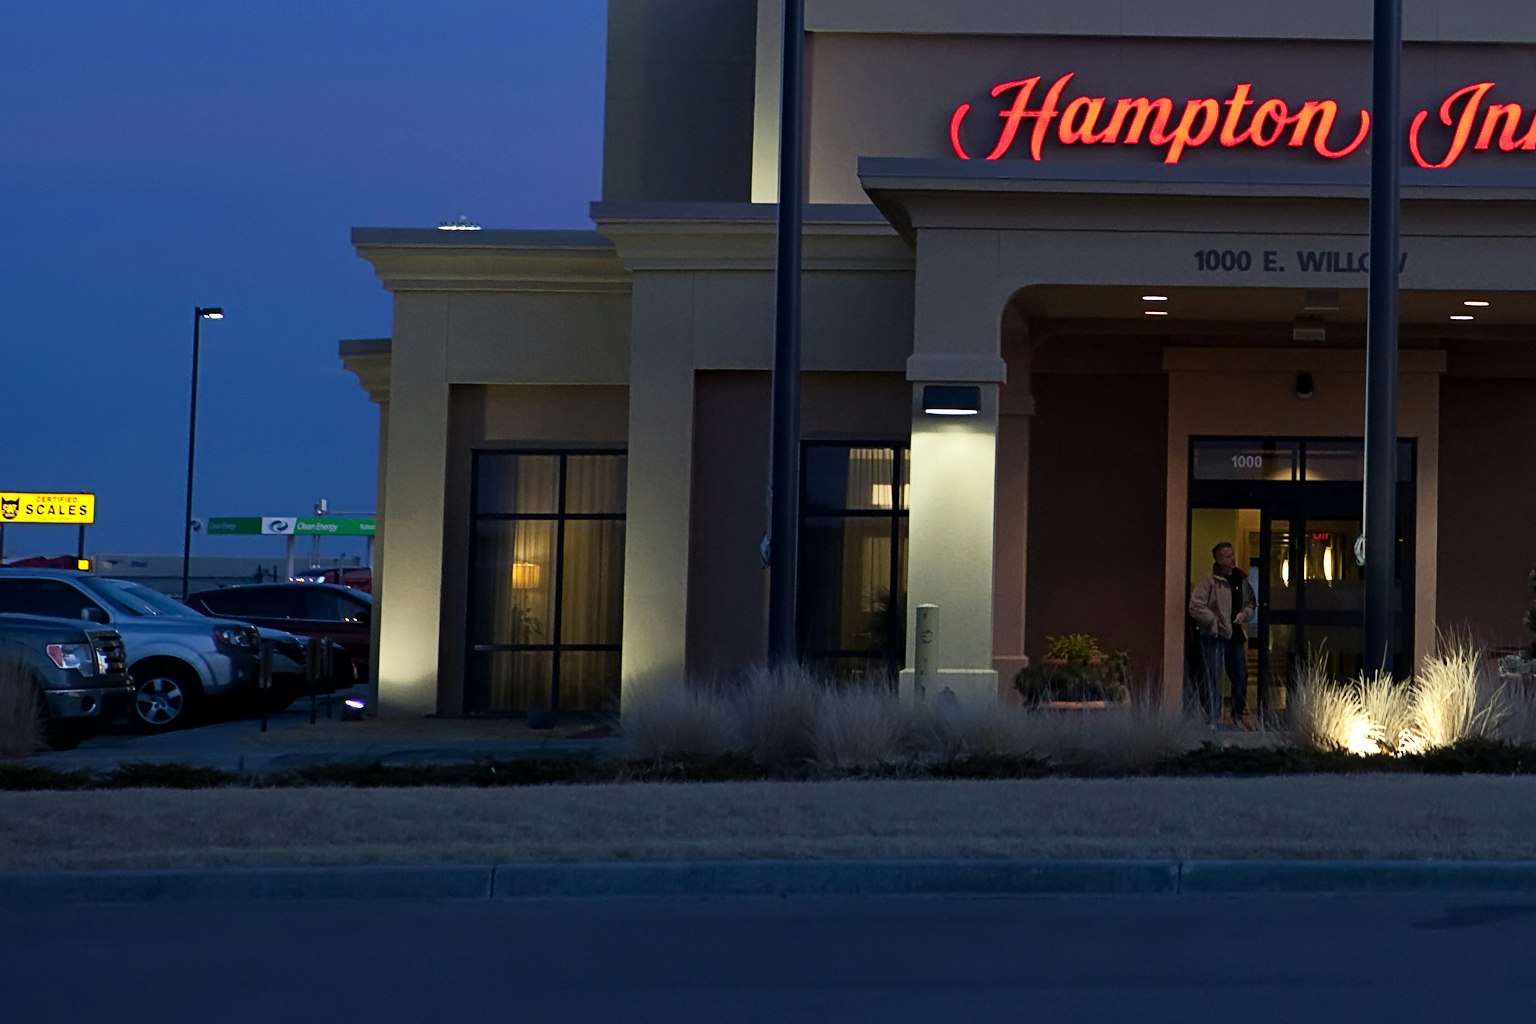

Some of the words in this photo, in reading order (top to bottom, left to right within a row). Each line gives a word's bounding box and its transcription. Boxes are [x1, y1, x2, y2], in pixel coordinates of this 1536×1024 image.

[948, 72, 1370, 164] Hampton
[1194, 249, 1251, 272] 1000
[1263, 251, 1285, 272] E.
[1231, 455, 1263, 467] 1000
[26, 504, 87, 515] SCALES
[297, 522, 315, 531] Clean
[316, 522, 338, 533] Energy
